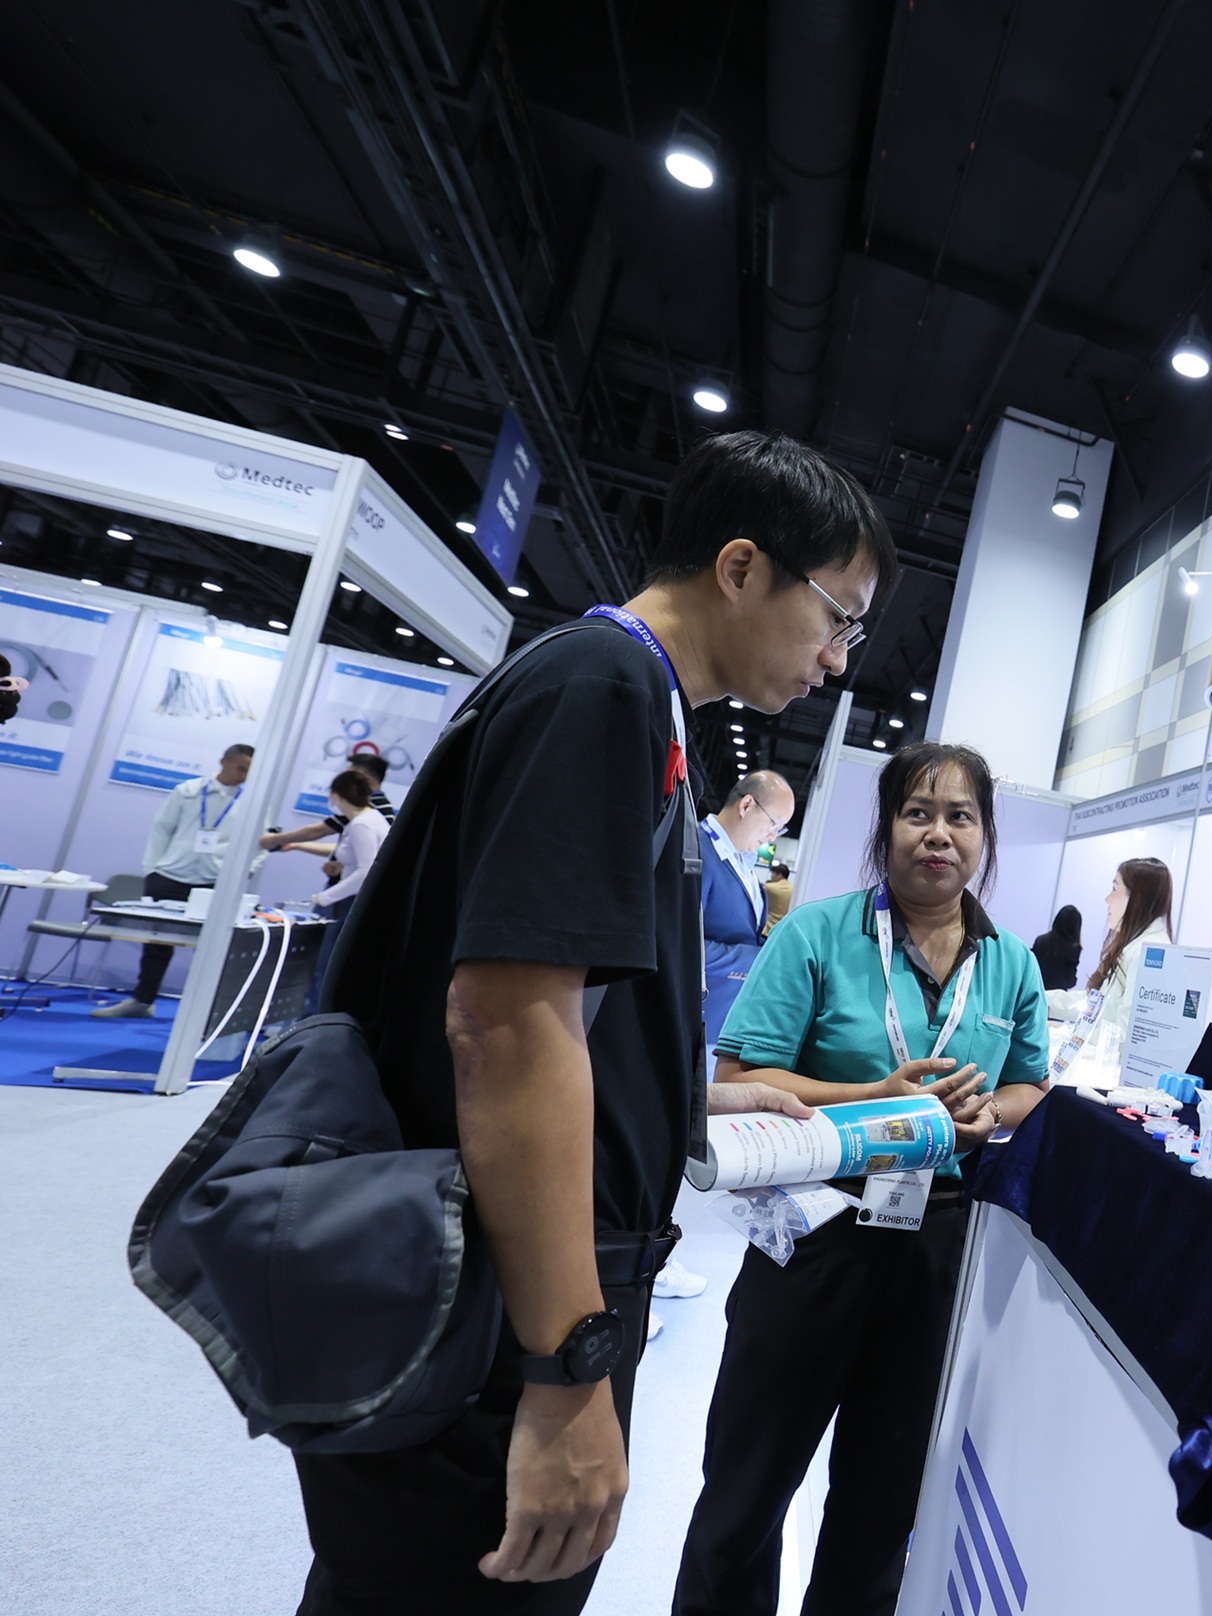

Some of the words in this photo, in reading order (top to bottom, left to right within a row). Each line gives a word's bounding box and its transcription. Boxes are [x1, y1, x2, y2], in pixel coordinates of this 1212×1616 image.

[241, 467, 315, 497] Medtec
[1139, 986, 1176, 1005] Certificate
[877, 1214, 921, 1226] EXHIBITOR
